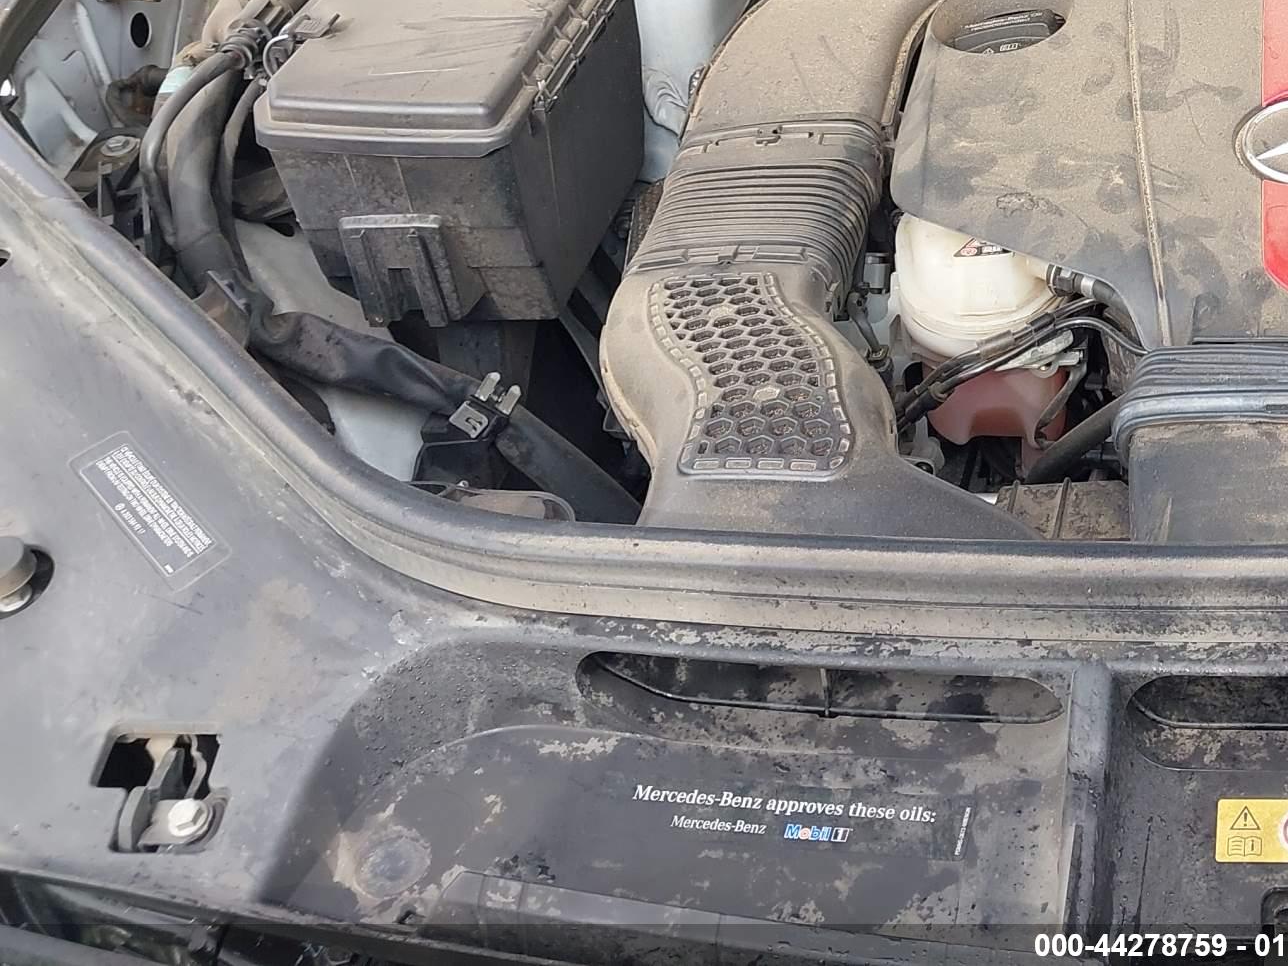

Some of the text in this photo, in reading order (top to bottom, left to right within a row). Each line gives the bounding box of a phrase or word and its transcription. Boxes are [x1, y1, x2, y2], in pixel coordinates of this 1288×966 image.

[632, 784, 937, 823] Mercedes-Benz approves these oils:
[670, 814, 767, 835] Mercedes-Benz
[783, 823, 831, 842] Mobil
